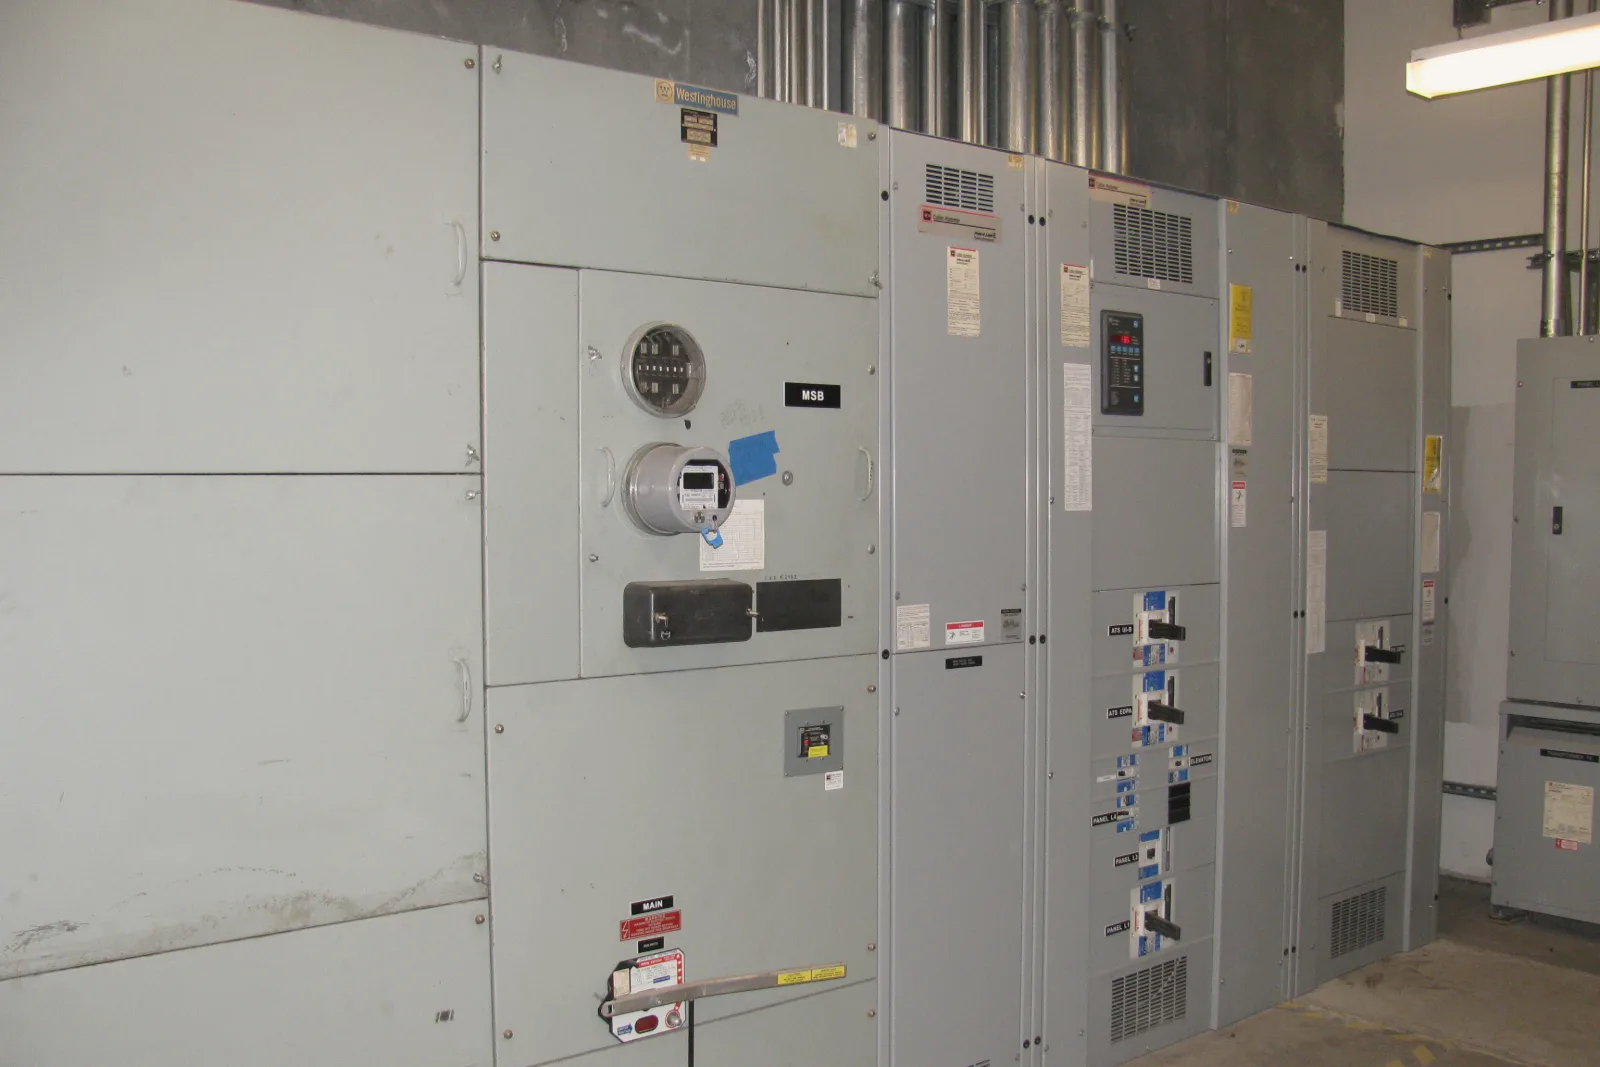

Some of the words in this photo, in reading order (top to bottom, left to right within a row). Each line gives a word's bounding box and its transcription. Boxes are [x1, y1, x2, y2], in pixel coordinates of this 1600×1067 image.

[676, 87, 736, 110] Westinghouse
[802, 390, 824, 401] MSB
[1190, 755, 1212, 764] ELEVATOR
[1093, 816, 1109, 824] PANEL
[1115, 857, 1131, 865] PANEL
[643, 900, 663, 911] MAIN
[1106, 924, 1122, 933] PANEL
